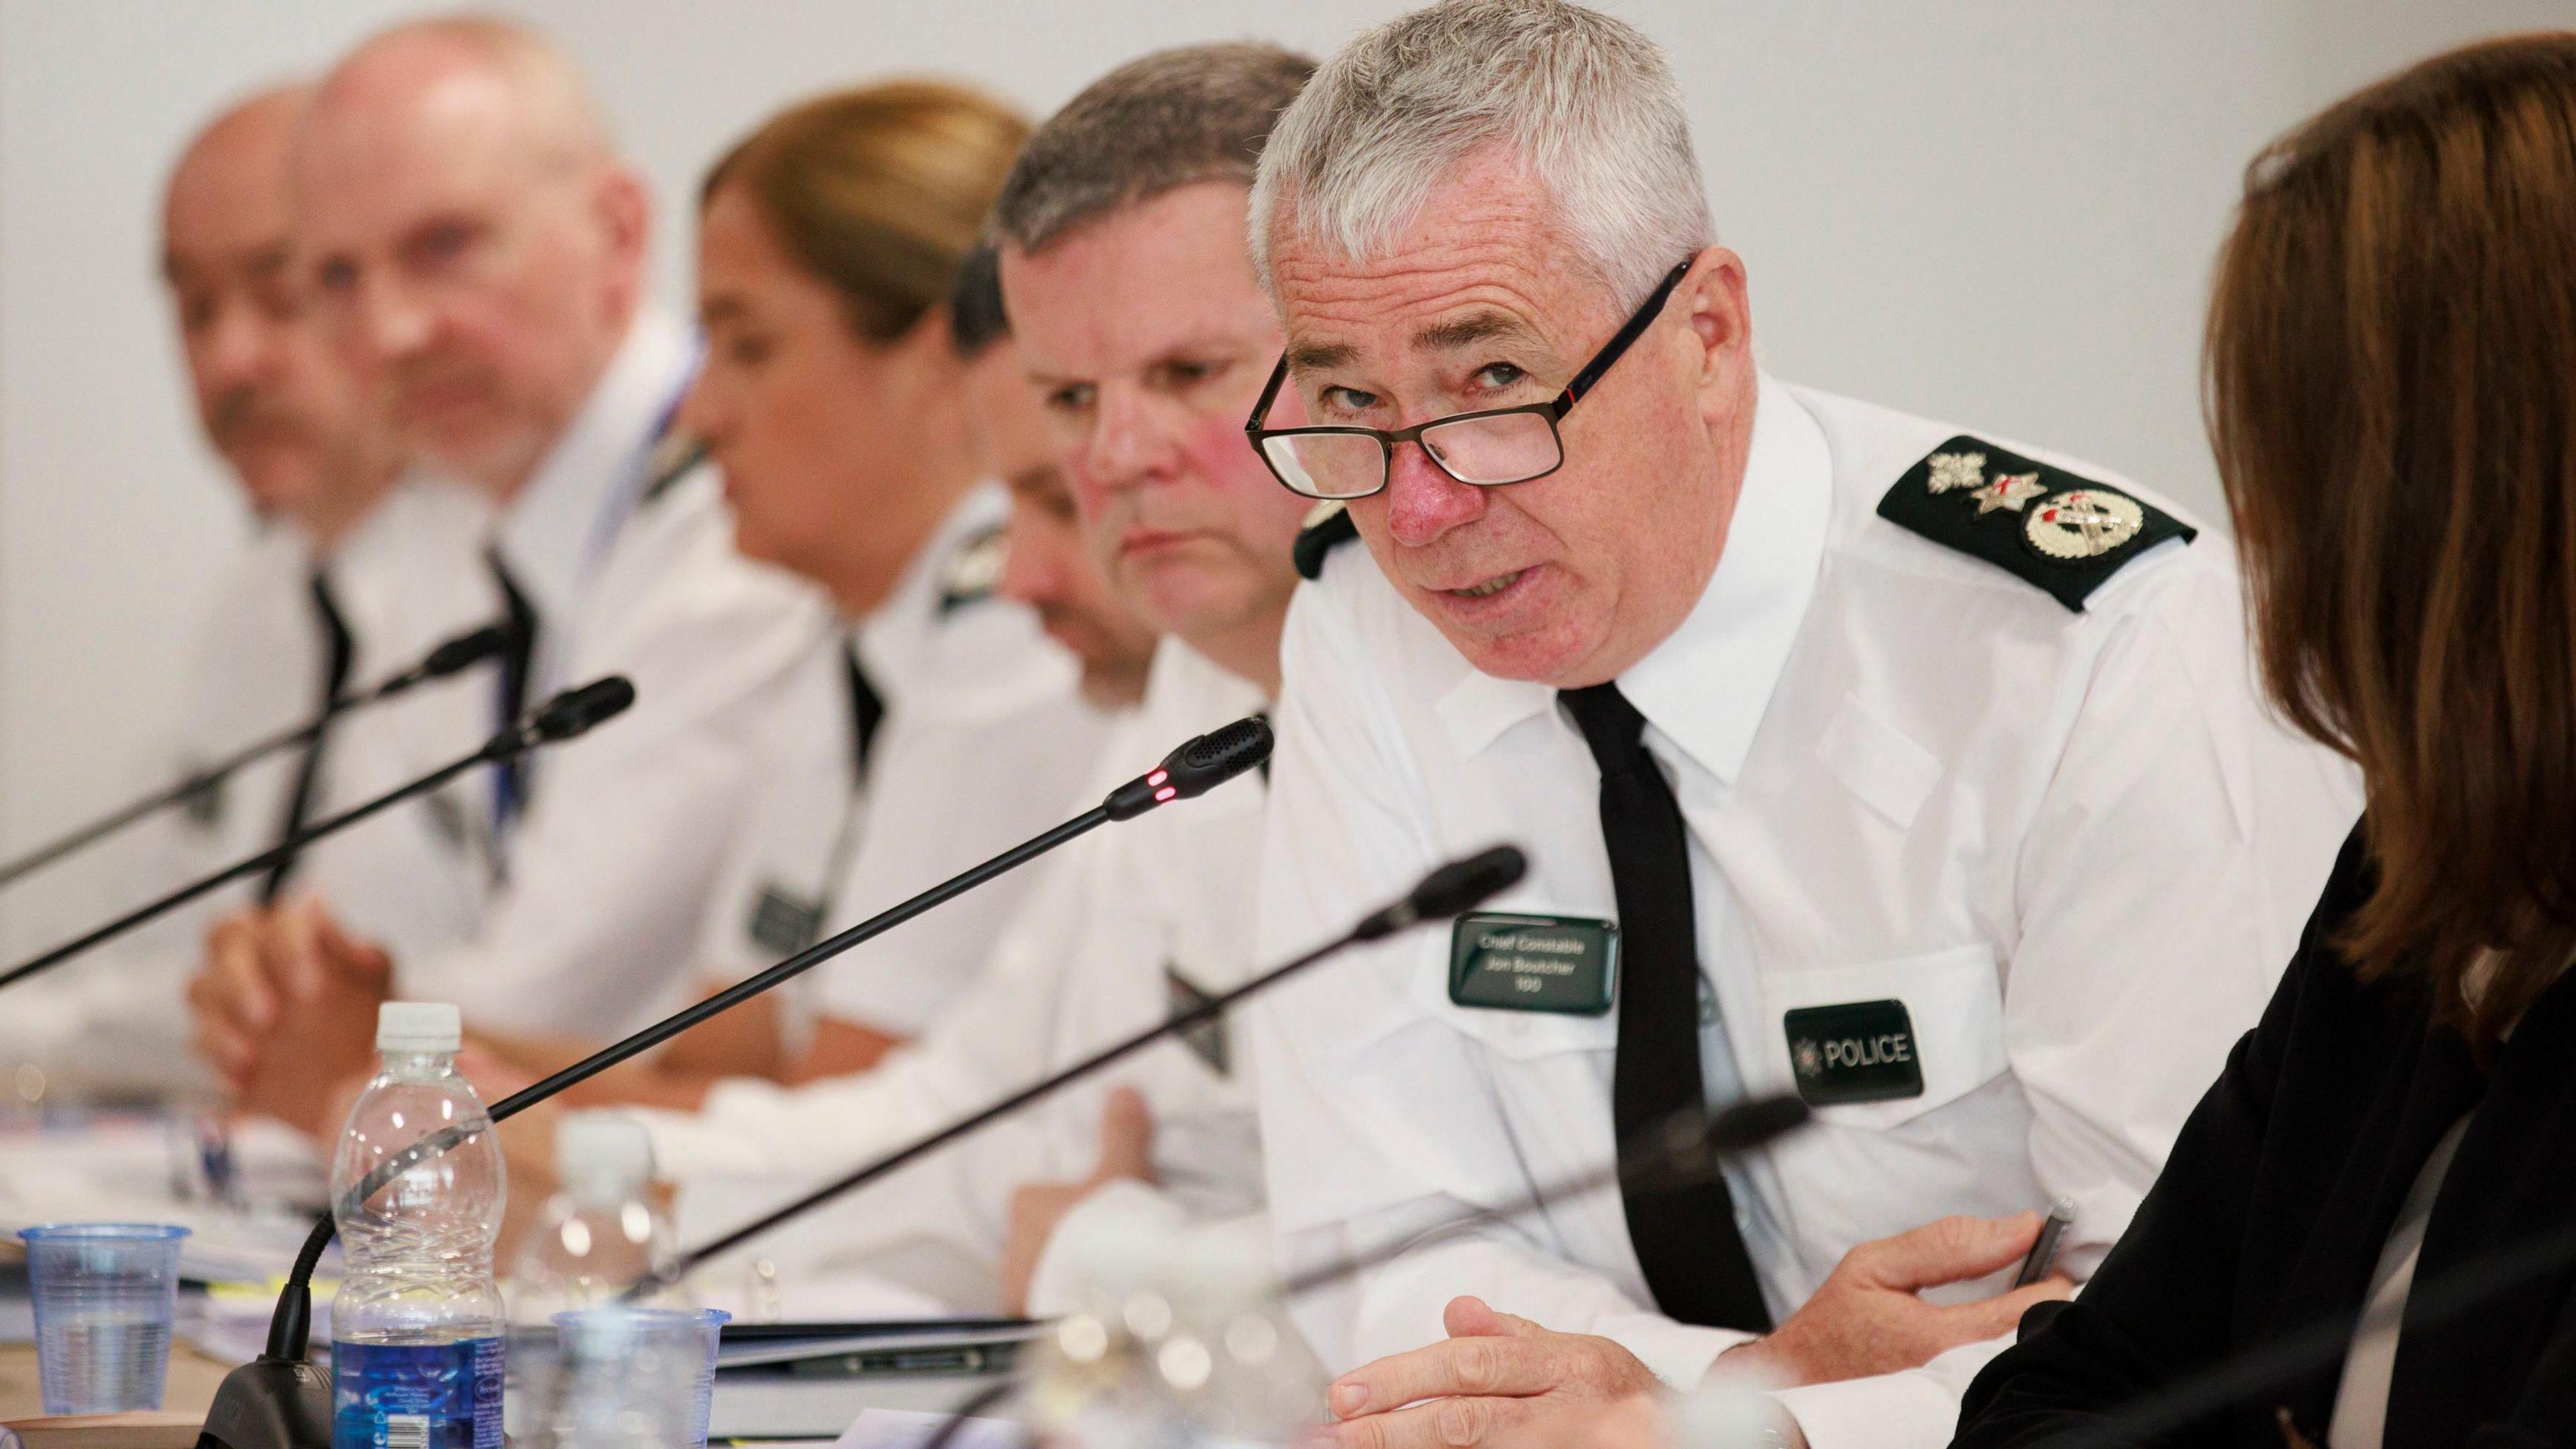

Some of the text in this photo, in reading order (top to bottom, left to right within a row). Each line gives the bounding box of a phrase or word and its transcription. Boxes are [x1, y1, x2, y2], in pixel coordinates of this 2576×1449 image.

[1479, 934, 1585, 955] Chief Constable
[1513, 956, 1576, 975] Boutcher
[1515, 975, 1542, 993] 100
[1824, 1033, 1911, 1068] POLICE
